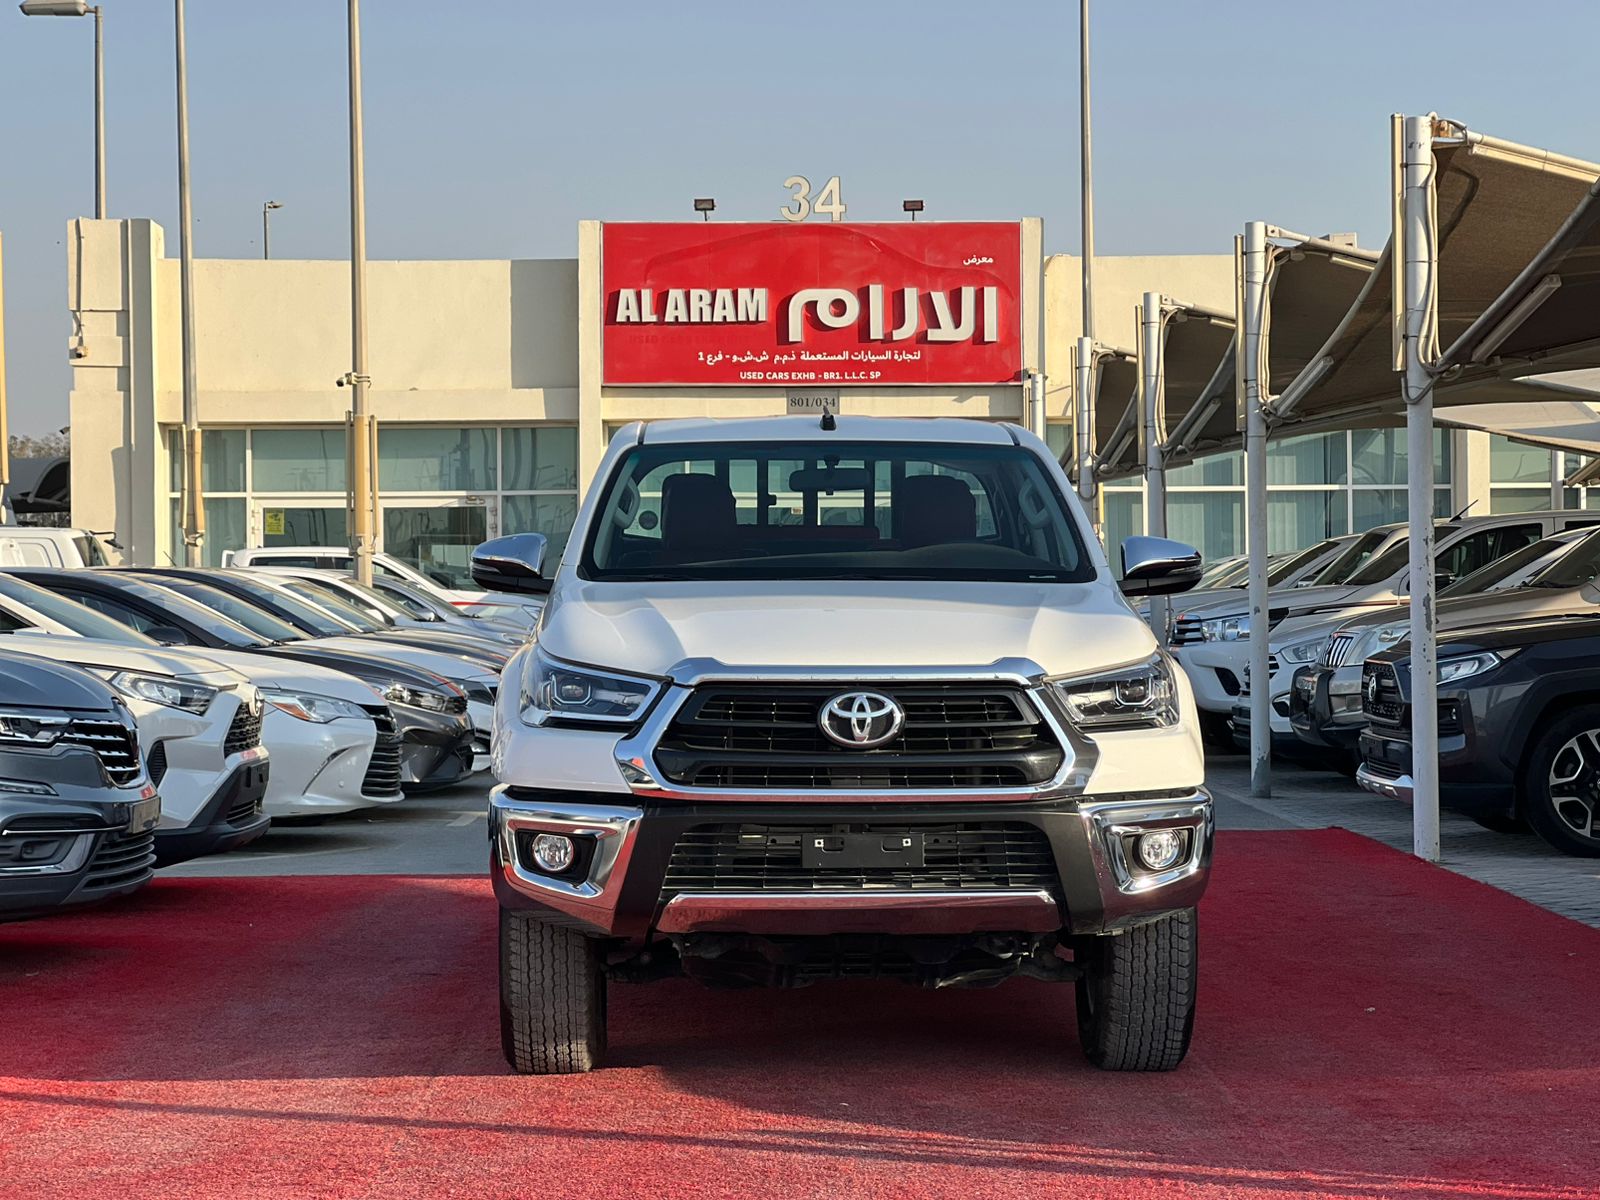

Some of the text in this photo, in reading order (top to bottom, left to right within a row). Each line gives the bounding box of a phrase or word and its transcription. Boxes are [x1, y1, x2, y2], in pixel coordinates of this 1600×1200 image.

[780, 175, 847, 222] 34
[962, 254, 993, 265] معرض
[616, 288, 768, 322] AL ARAM
[698, 352, 704, 361] 1
[706, 351, 723, 365] فرع
[800, 350, 849, 361] المستعملة
[851, 350, 891, 362] السيارات
[893, 350, 921, 362] لتجارة
[740, 372, 764, 380] USED
[766, 372, 790, 380] CARS
[791, 372, 816, 380] EXHB
[870, 371, 881, 380] SP
[790, 397, 836, 407] 801/034
